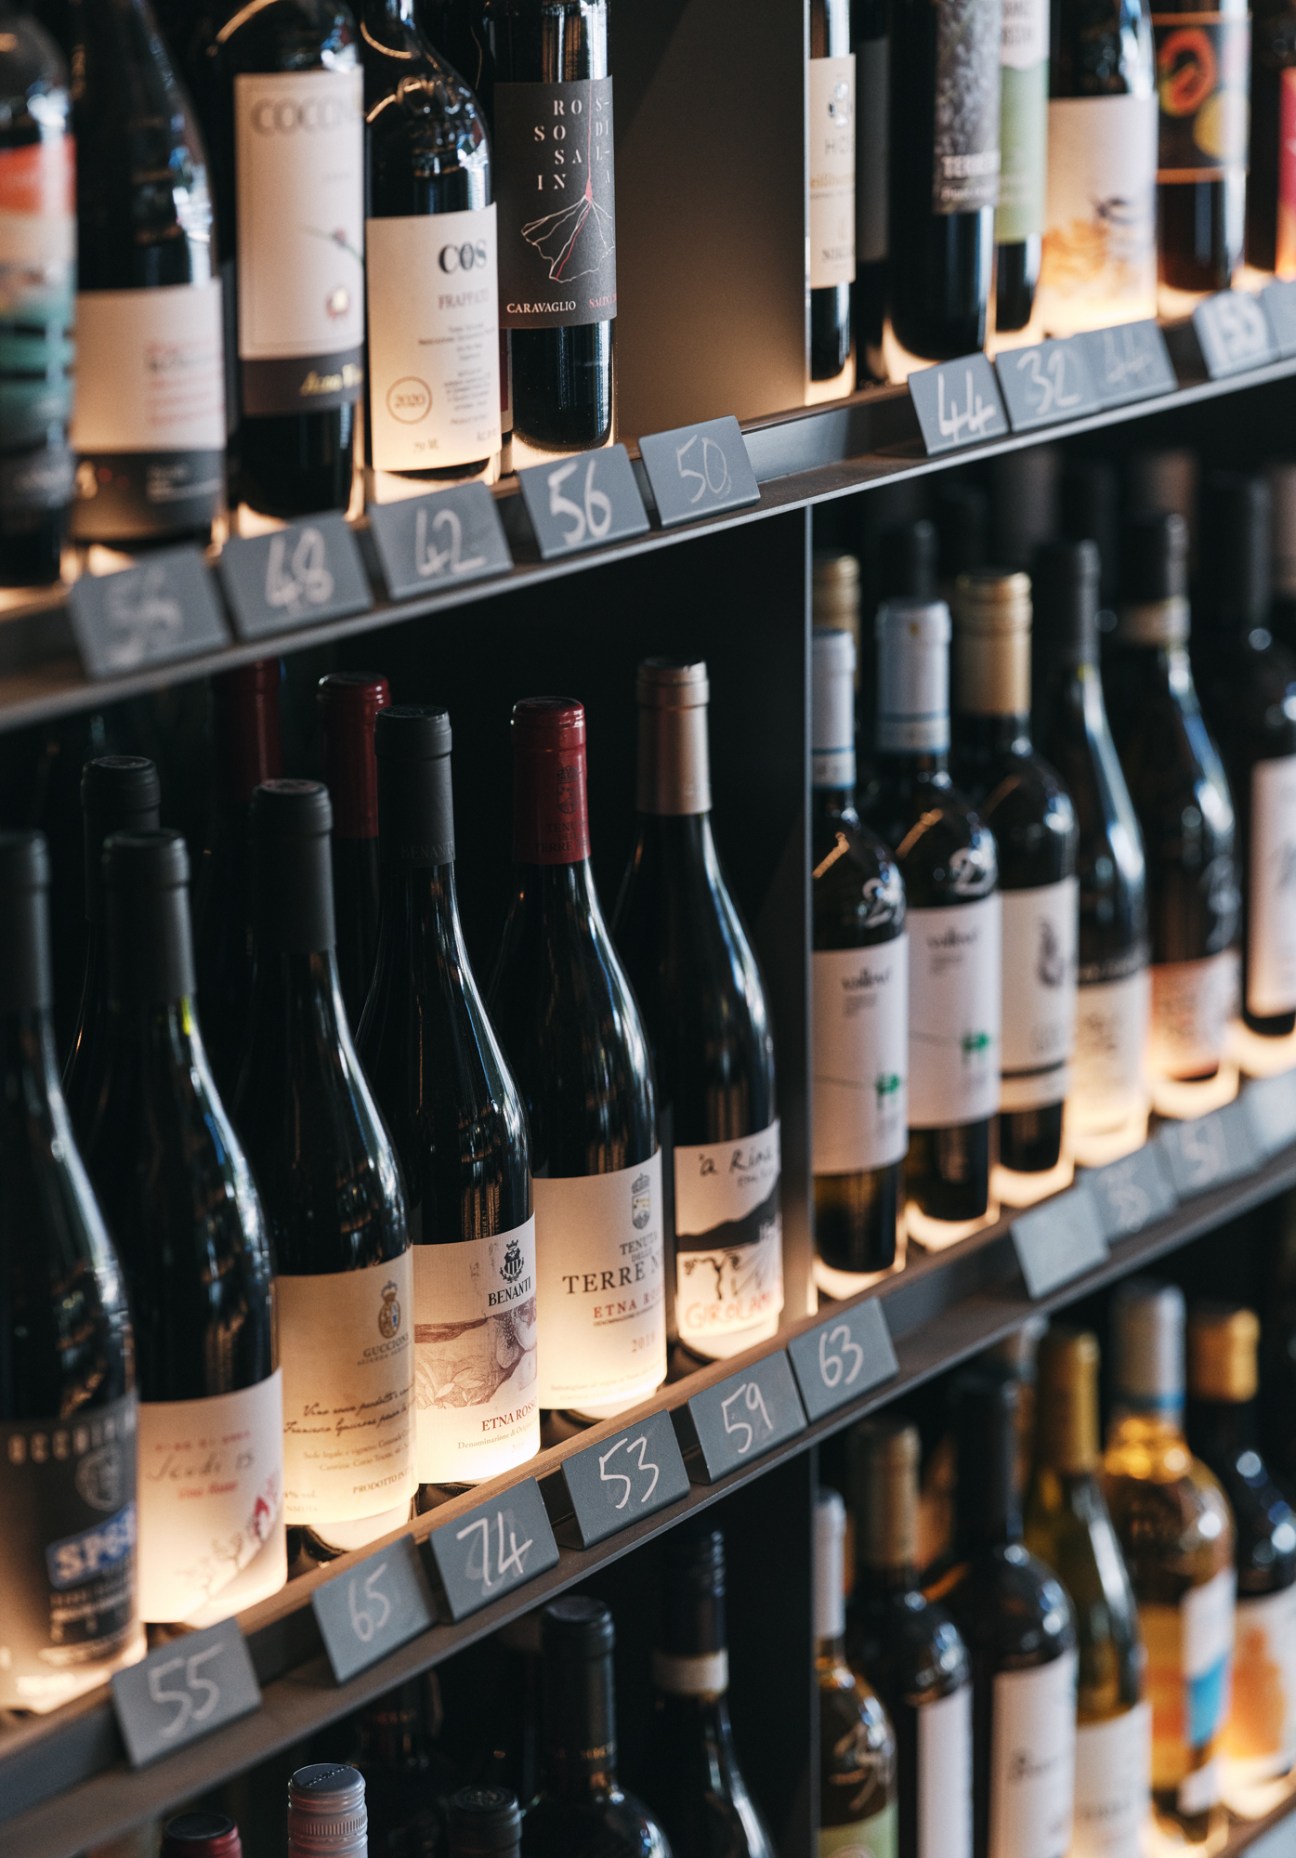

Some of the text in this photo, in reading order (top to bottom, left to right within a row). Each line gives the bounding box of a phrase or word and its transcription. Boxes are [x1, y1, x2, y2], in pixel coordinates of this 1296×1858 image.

[437, 240, 487, 275] COS
[506, 300, 577, 314] CARAVAGLIO
[937, 368, 995, 443] 44
[1016, 351, 1081, 415] 32
[676, 434, 733, 502] 50
[547, 458, 612, 545] 56
[488, 1276, 531, 1307] BENANTI
[561, 1260, 646, 1295] TERRE
[593, 1298, 637, 1319] ETNA
[819, 1324, 864, 1388] 63
[481, 1412, 514, 1432] ETNA
[721, 1381, 774, 1453] 59
[599, 1434, 659, 1509] 53
[457, 1511, 533, 1586] 74
[347, 1561, 390, 1643] 65
[148, 1641, 225, 1738] 55
